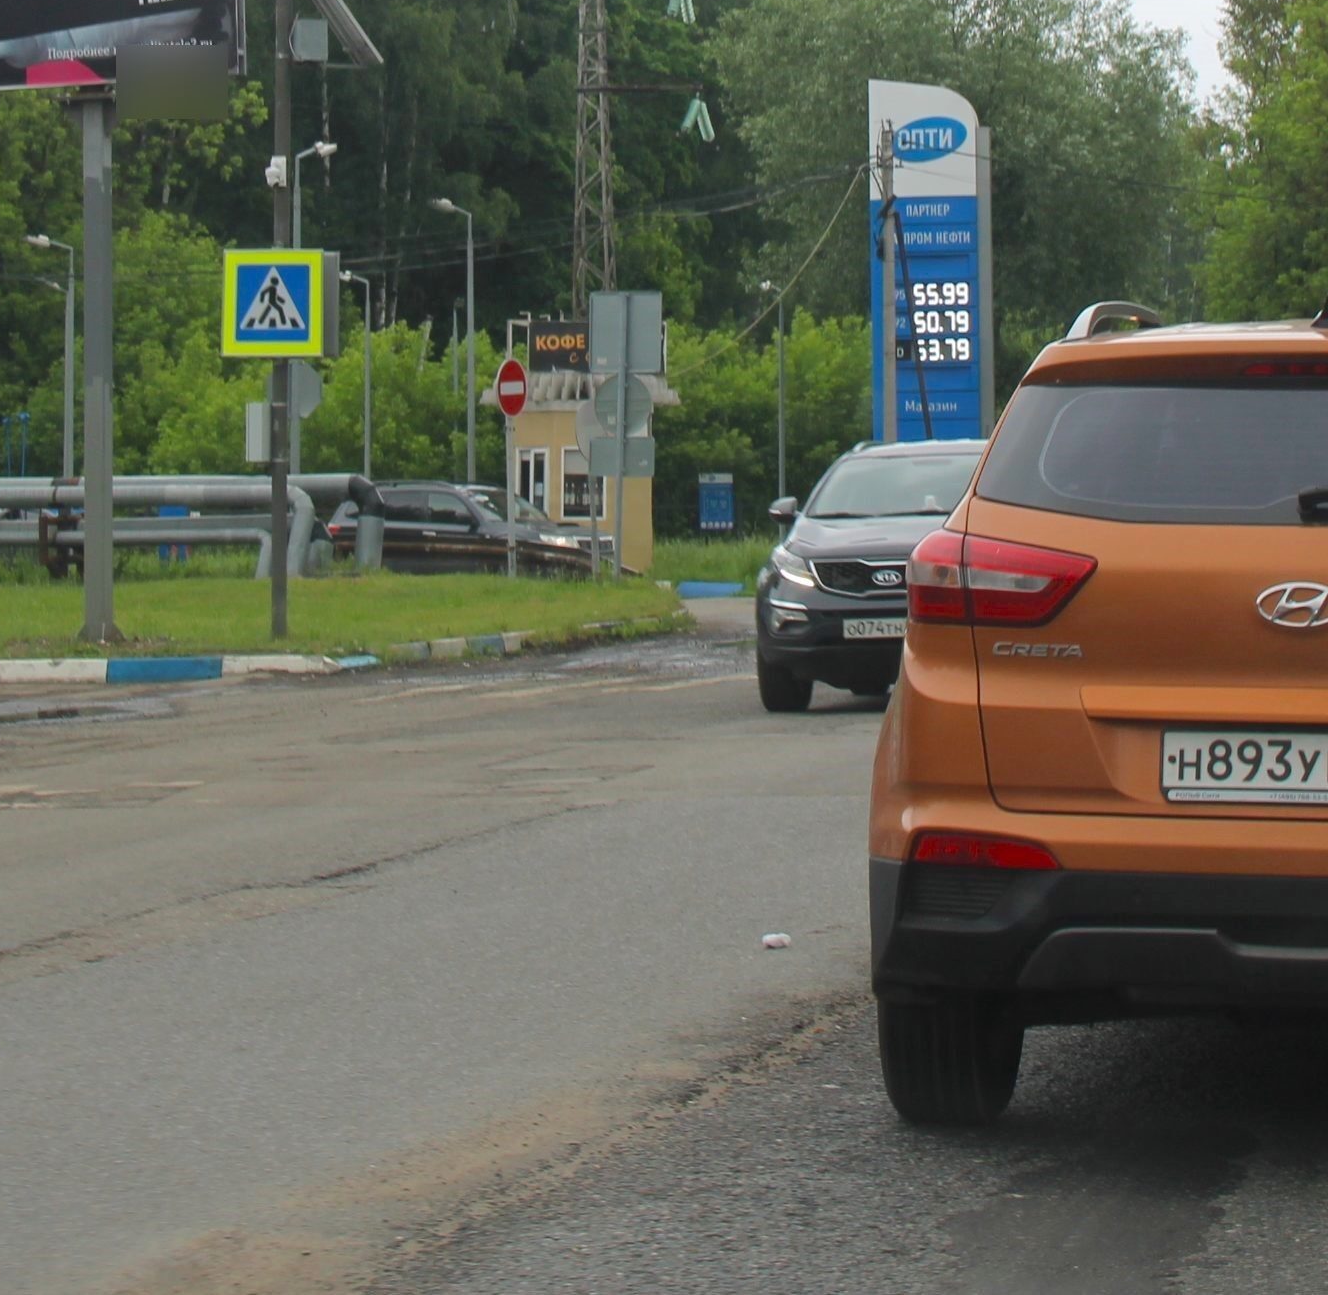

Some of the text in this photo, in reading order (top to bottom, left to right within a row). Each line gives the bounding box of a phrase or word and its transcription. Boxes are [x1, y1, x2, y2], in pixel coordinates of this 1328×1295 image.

[48, 46, 112, 62] Подробнее
[905, 203, 950, 218] ПАРТНЕР
[936, 230, 970, 245] НЕФТИ
[913, 282, 969, 306] 55.99
[913, 310, 970, 334] 50.79
[535, 334, 586, 351] КОФЕ
[905, 400, 958, 413] Маазин
[875, 572, 899, 584] KIA
[992, 641, 1083, 657] CRETA
